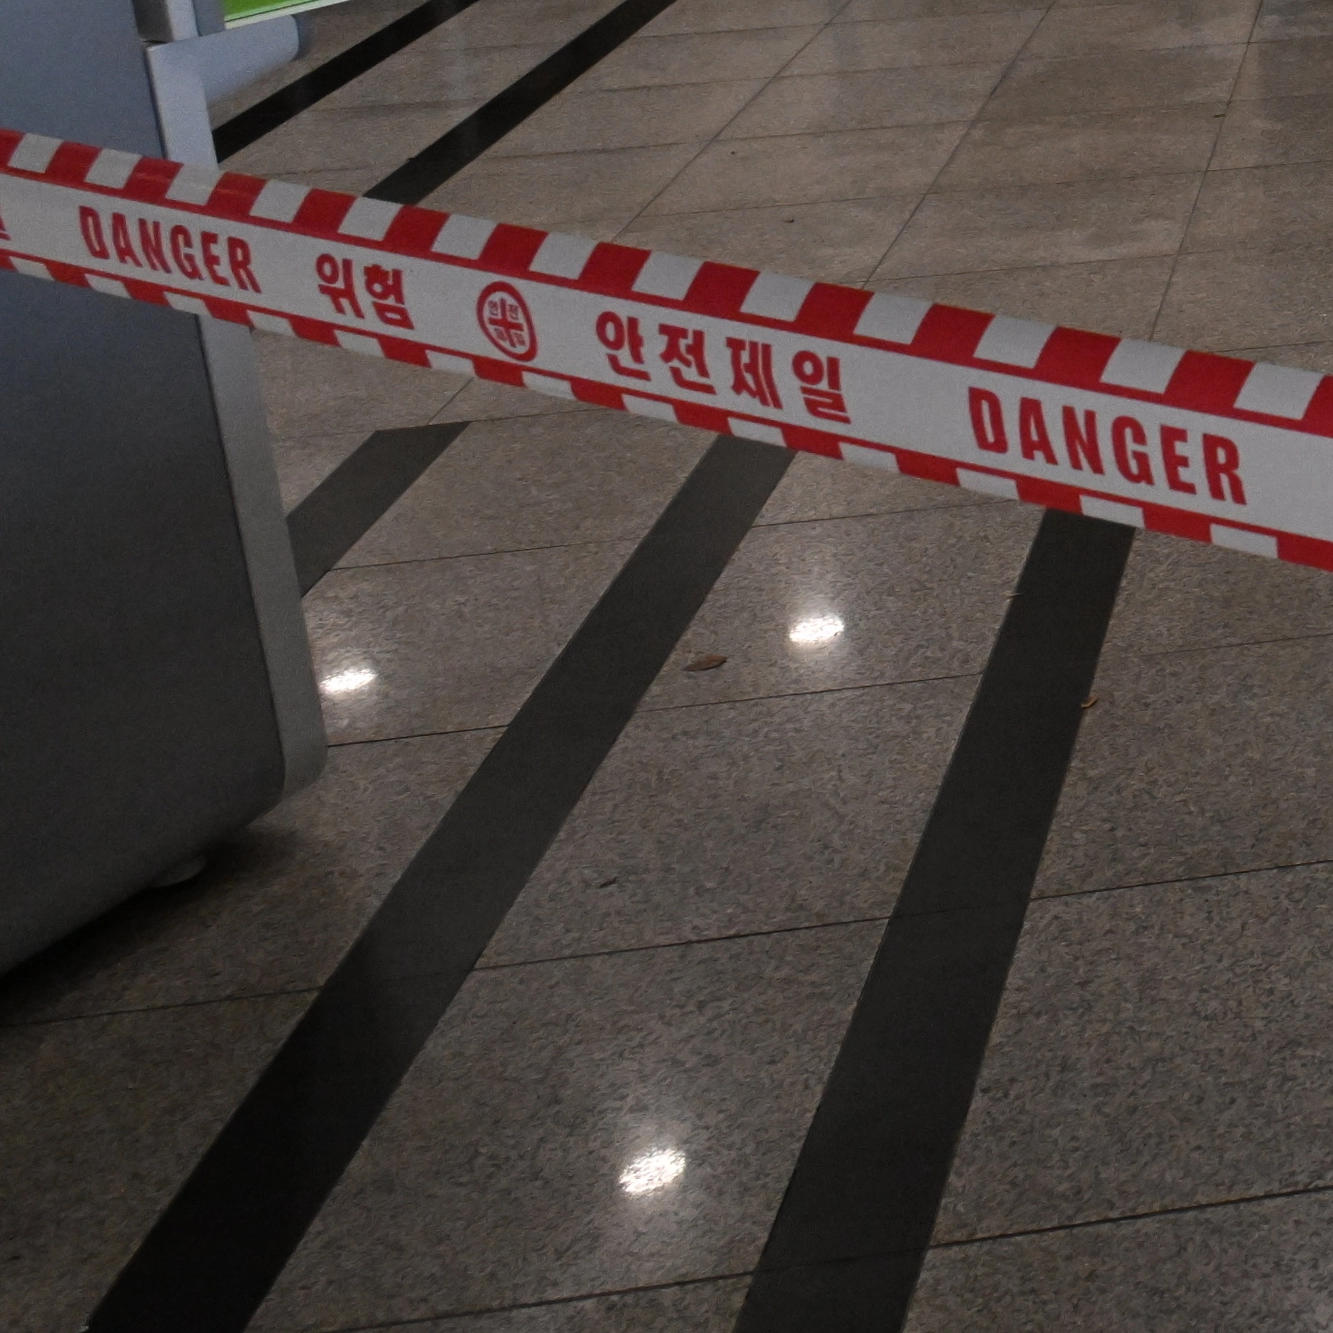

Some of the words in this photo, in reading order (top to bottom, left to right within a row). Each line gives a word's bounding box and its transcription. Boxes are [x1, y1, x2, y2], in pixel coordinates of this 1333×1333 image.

[79, 206, 262, 294] DANGER
[315, 252, 415, 330] 위험
[595, 309, 852, 425] 안전제일
[968, 386, 1247, 505] DANGER
